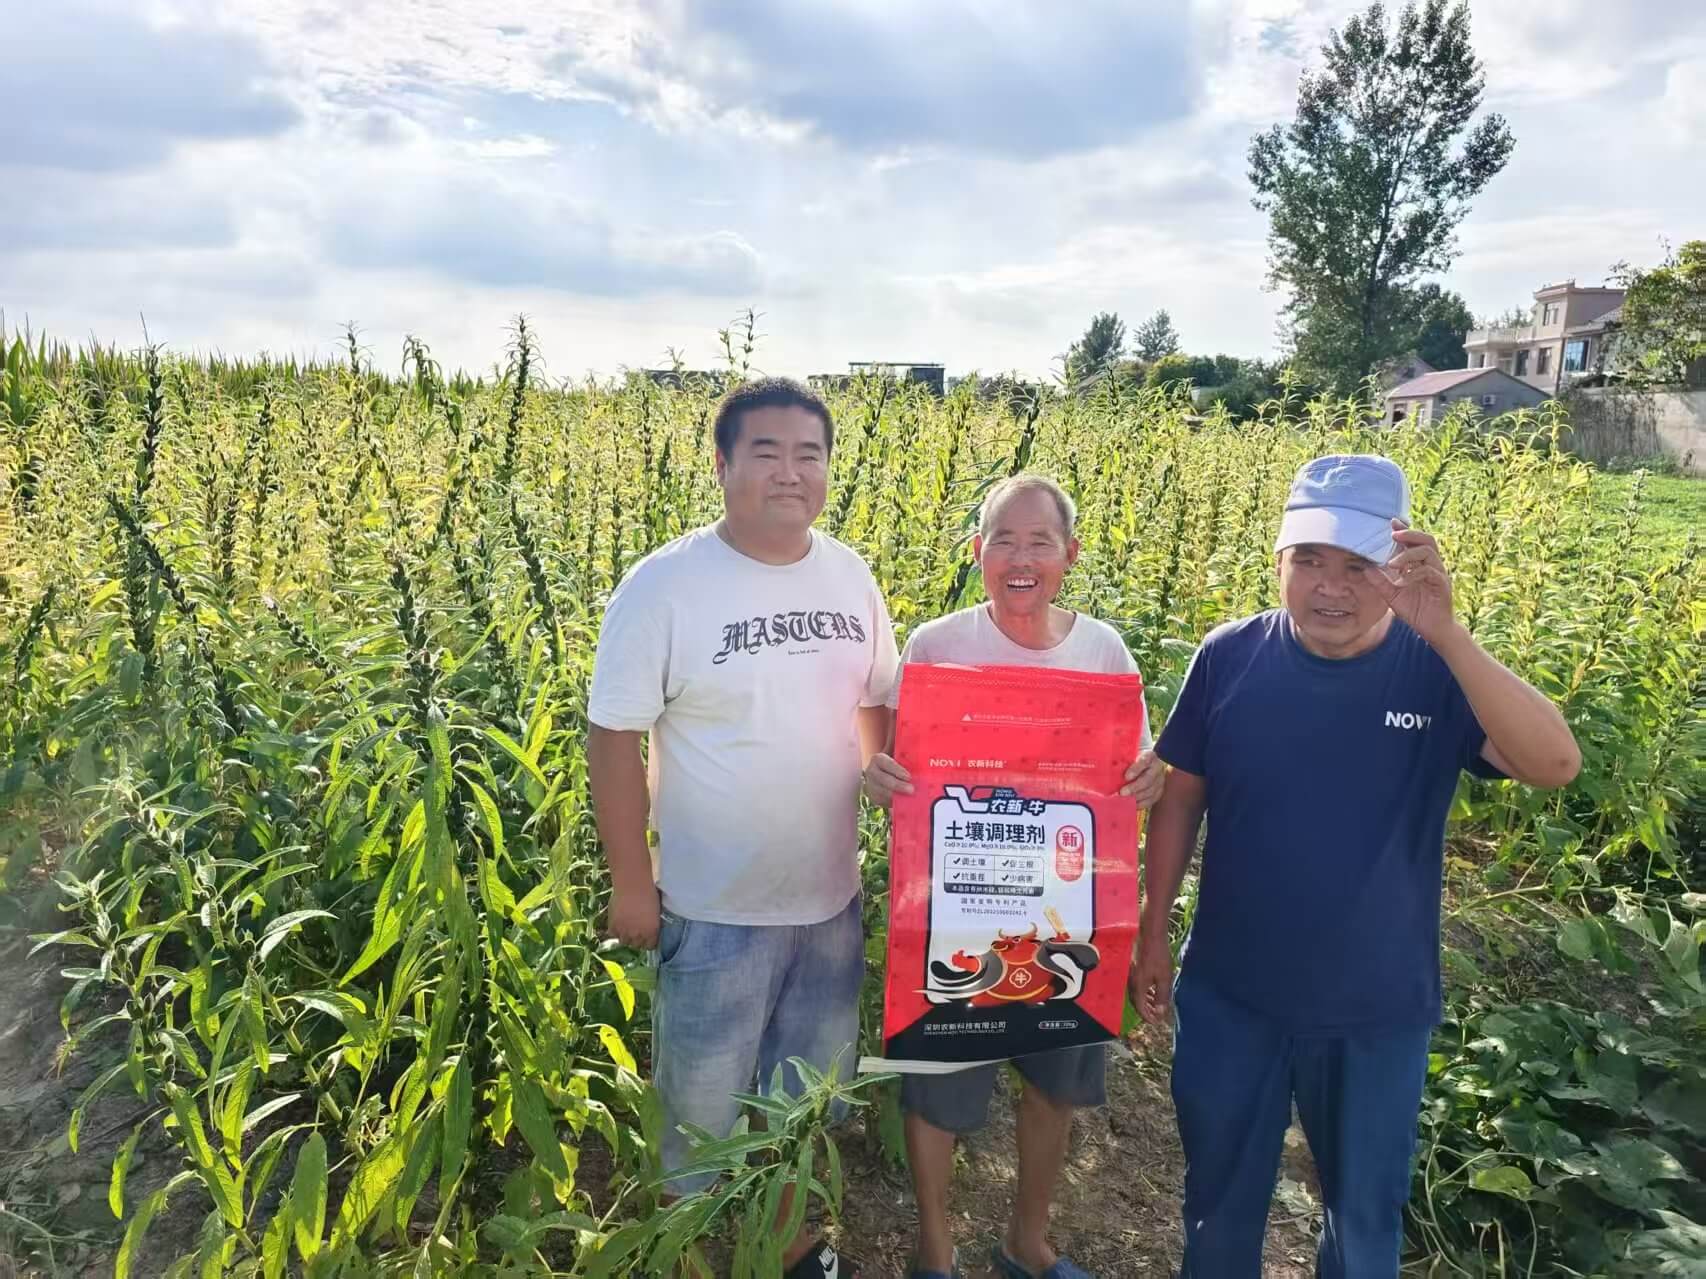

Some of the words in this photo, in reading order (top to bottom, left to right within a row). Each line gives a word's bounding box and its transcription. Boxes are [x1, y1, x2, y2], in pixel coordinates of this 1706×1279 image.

[712, 610, 866, 664] MASTERS
[944, 820, 1046, 845] 土壤调理剂
[1062, 831, 1078, 847] 新
